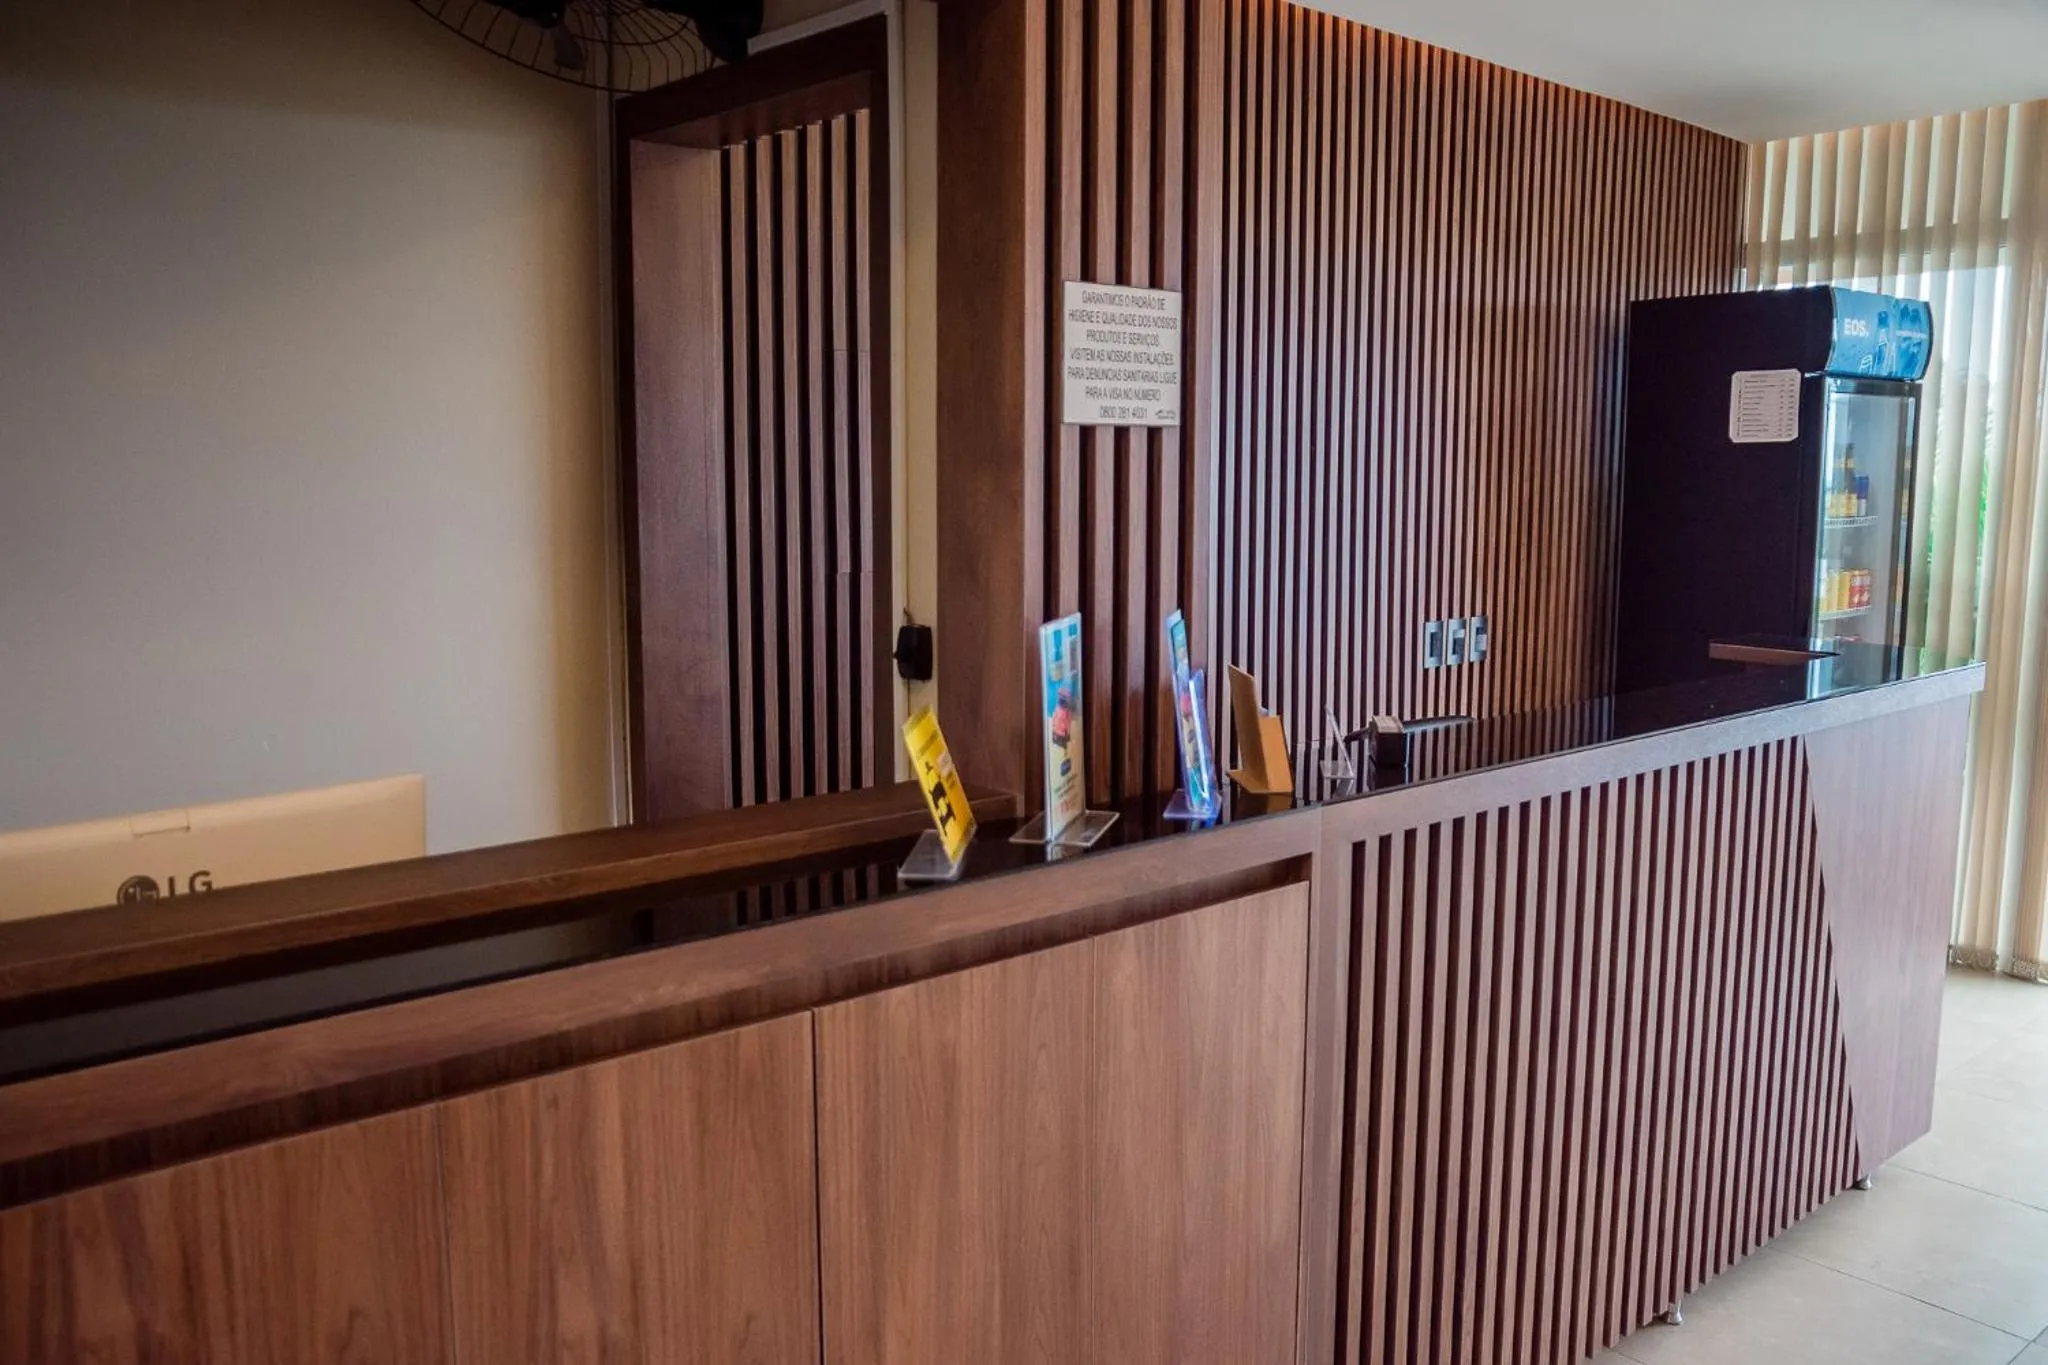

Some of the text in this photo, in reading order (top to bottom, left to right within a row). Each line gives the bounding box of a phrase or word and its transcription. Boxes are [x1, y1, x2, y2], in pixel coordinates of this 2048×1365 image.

[1082, 290, 1123, 306] GARANTIMOS
[1157, 298, 1167, 311] DE
[1068, 309, 1094, 323] HIGIENE
[1102, 311, 1138, 327] QUALIDADE
[1138, 313, 1152, 328] DOS
[1152, 315, 1178, 330] NOSSOS
[1086, 329, 1120, 343] PRODUTOS
[1096, 349, 1105, 361] AS
[1106, 349, 1132, 363] NOSSAS
[1067, 366, 1084, 380] PARA
[1085, 386, 1102, 400] PARA
[1108, 387, 1122, 400] VISA
[1123, 388, 1133, 400] NO
